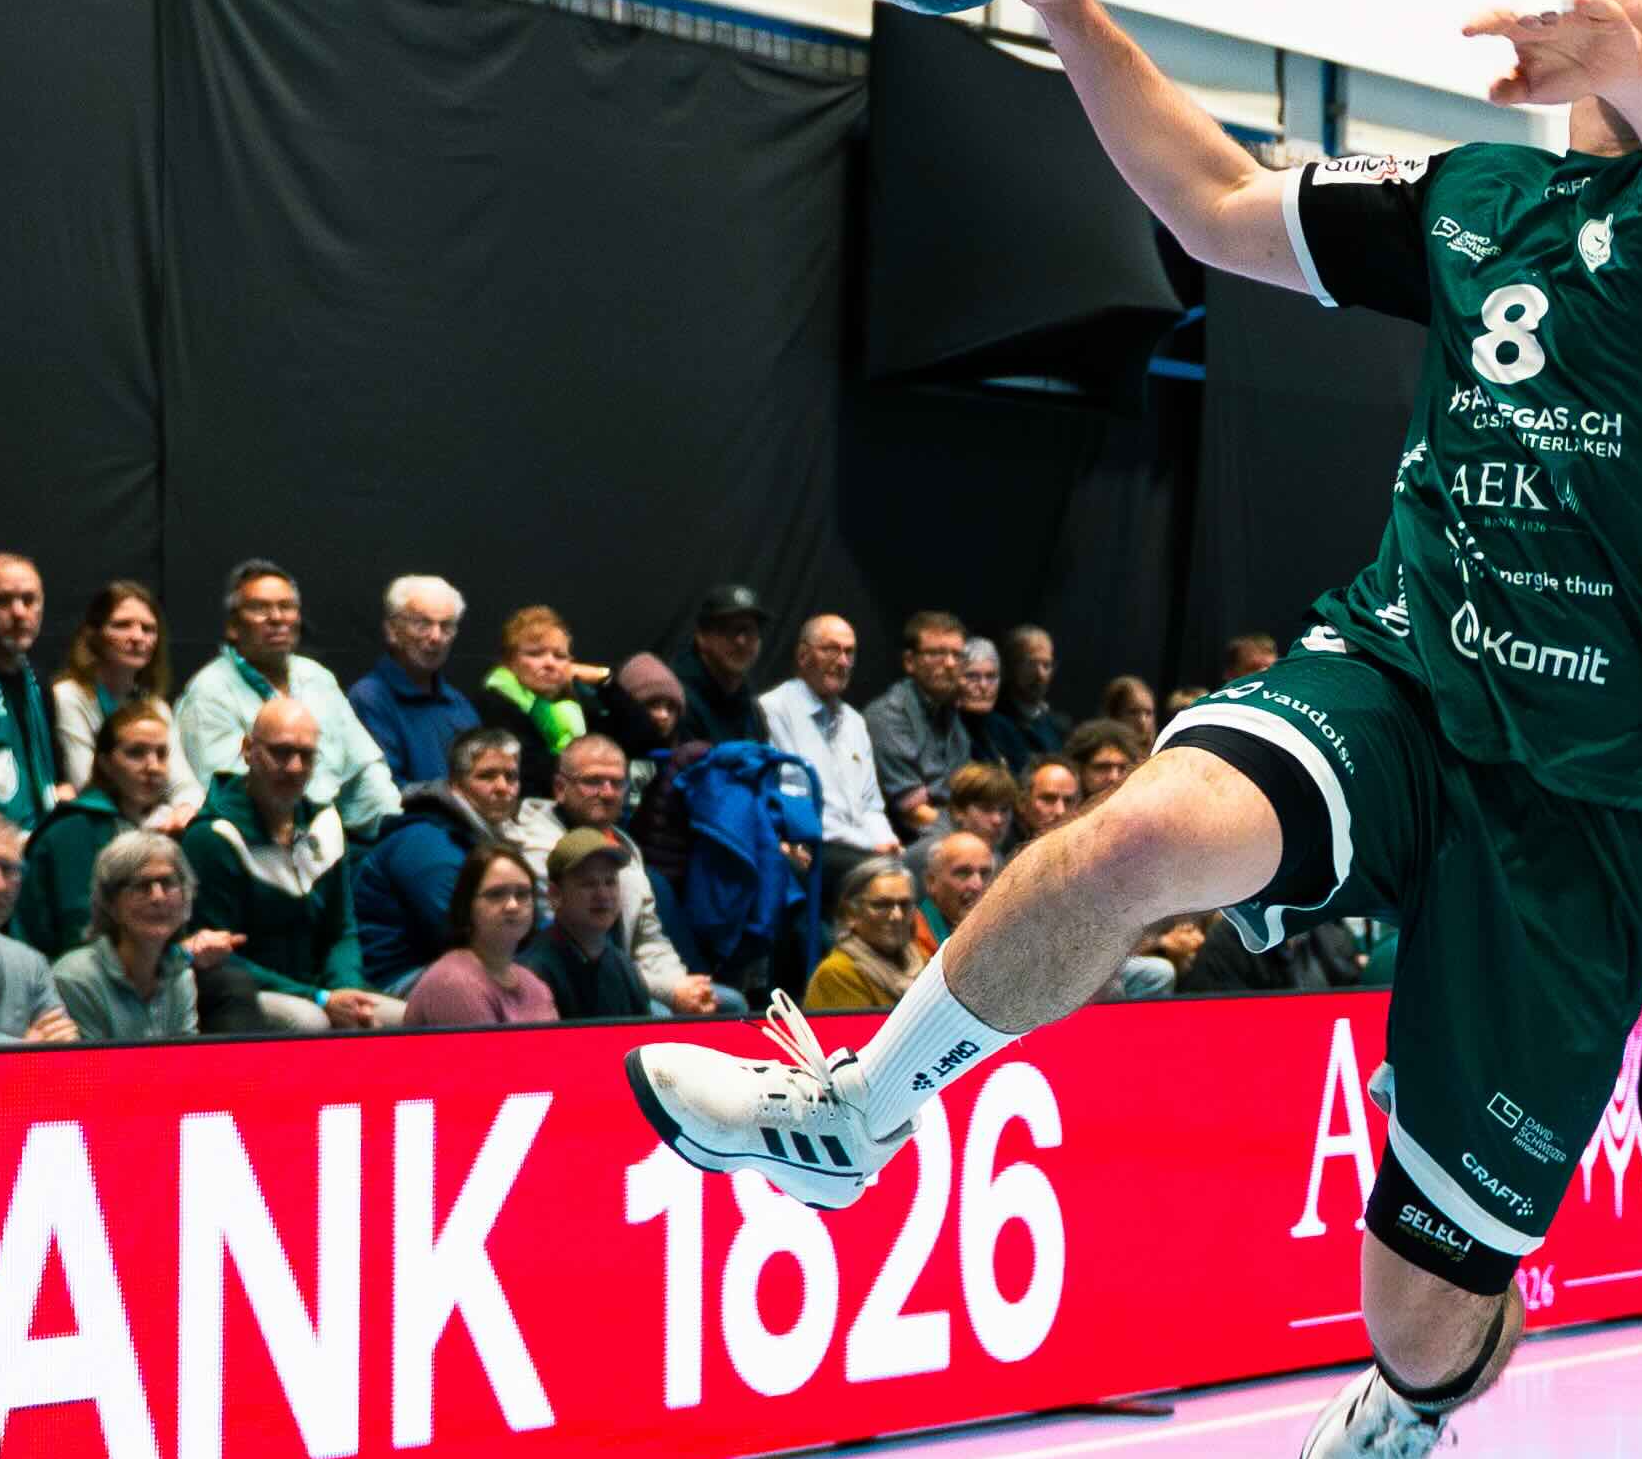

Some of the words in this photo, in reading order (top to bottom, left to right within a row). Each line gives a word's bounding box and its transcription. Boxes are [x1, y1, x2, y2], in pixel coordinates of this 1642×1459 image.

[1471, 282, 1549, 385] 8
[1450, 462, 1550, 512] AEK
[1492, 565, 1559, 592] nergie
[1565, 575, 1614, 597] thun
[930, 1039, 981, 1079] CRAFT
[1524, 1117, 1555, 1142] DAVID
[1461, 1151, 1524, 1210] CRAFT
[624, 1060, 1067, 1409] 1826
